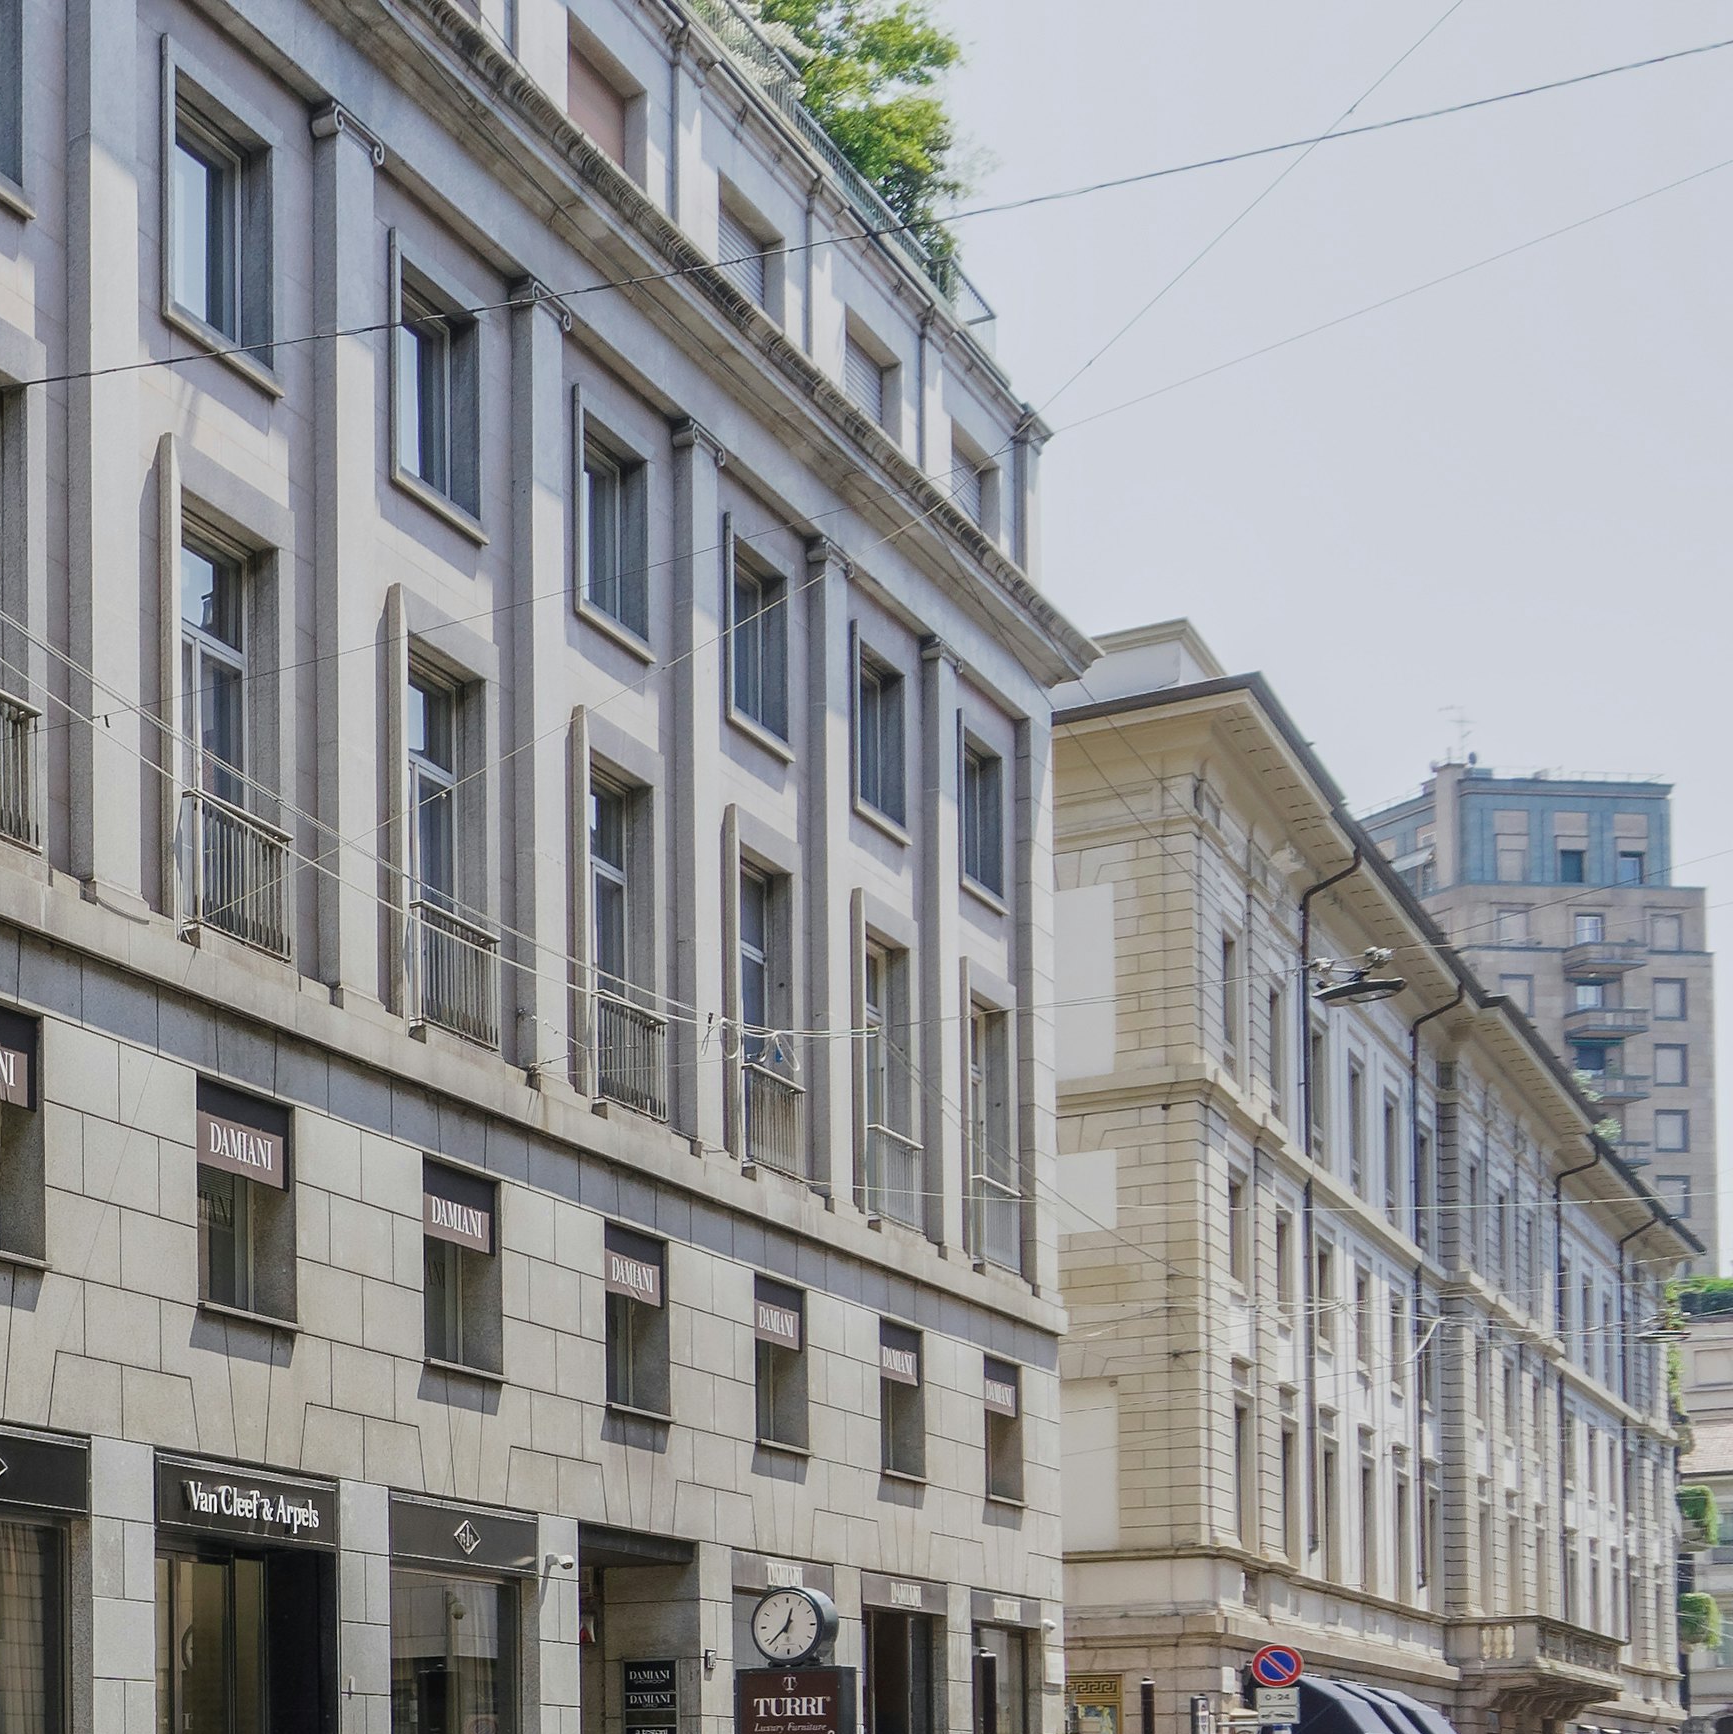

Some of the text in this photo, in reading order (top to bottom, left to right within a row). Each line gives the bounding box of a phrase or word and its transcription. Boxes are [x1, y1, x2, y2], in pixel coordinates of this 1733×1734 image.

[209, 1121, 273, 1171] DAMIANI
[431, 1195, 483, 1239] DAMIANI
[611, 1256, 654, 1294] DAMIANI
[758, 1306, 795, 1338] DAMIANI
[882, 1345, 913, 1376] DAMIANI
[188, 1480, 320, 1534] Van Cleef & Arpels
[629, 1671, 670, 1680] DAMIANI
[629, 1694, 671, 1704] DAMIANI
[753, 1696, 827, 1717] TURRI
[754, 1721, 828, 1734] Luxury Furniture
